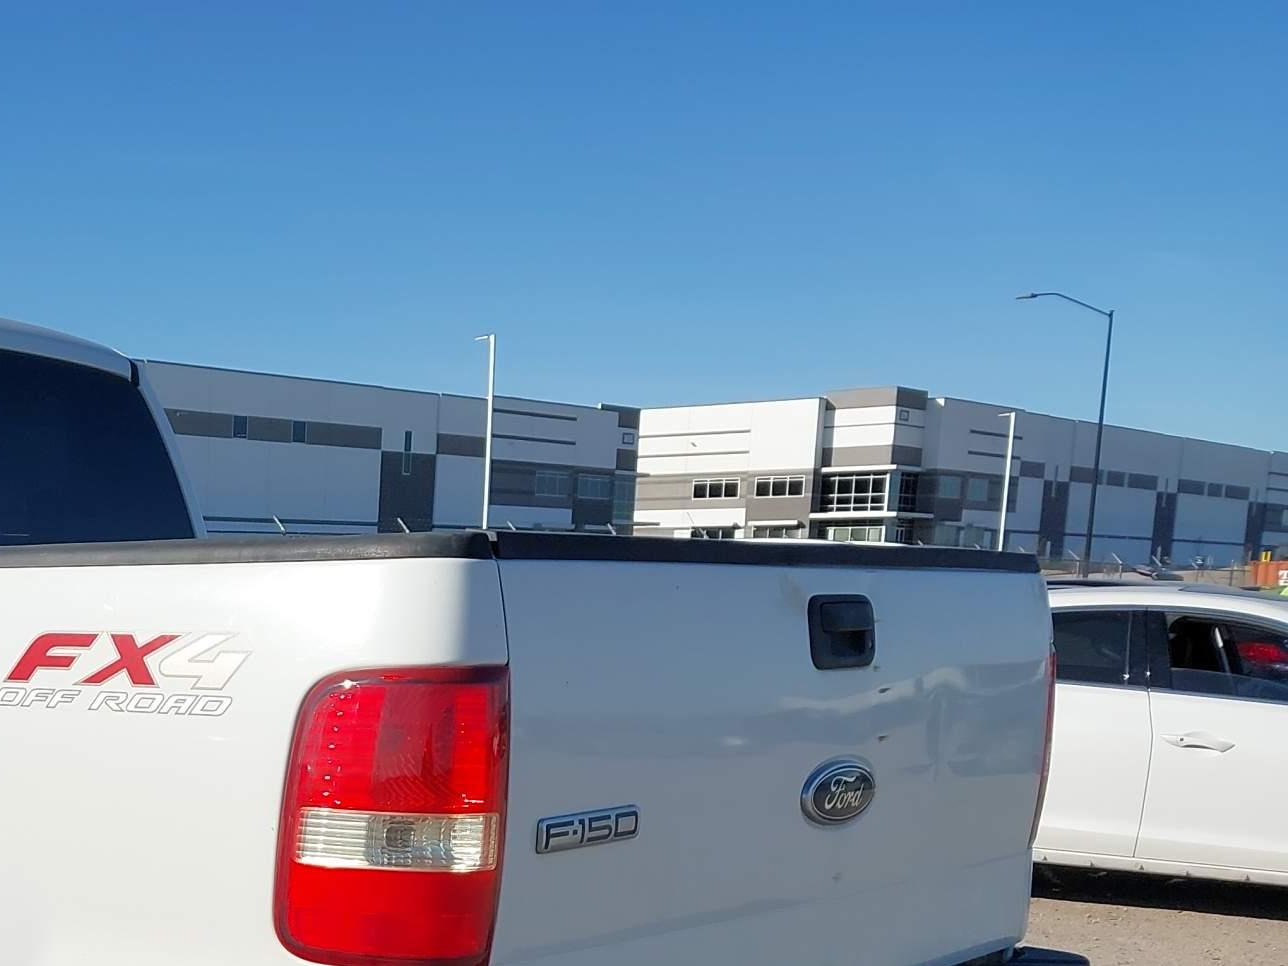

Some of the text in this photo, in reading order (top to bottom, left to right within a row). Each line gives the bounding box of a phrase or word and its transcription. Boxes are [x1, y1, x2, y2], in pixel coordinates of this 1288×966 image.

[3, 631, 253, 690] FX4
[88, 690, 232, 717] ROAD
[824, 774, 865, 811] Ford
